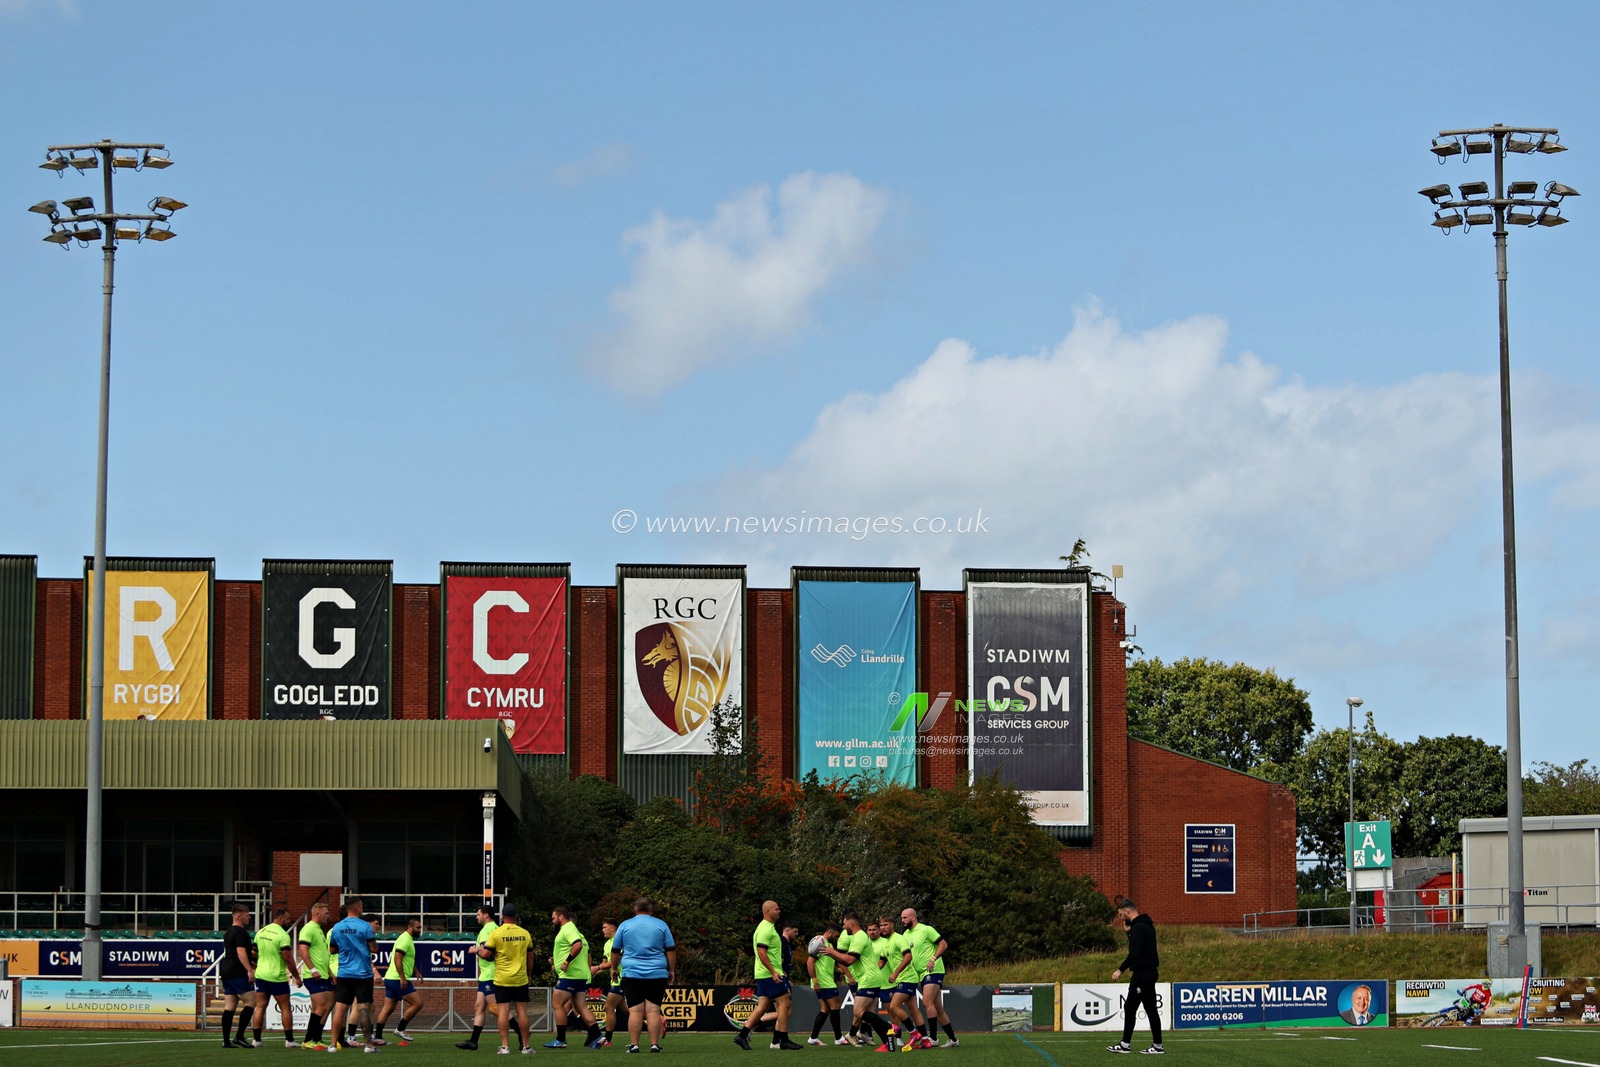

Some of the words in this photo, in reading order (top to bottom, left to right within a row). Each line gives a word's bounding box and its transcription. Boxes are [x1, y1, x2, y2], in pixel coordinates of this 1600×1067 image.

[652, 596, 717, 620] RGC
[118, 586, 177, 671] R
[299, 587, 356, 669] G
[473, 590, 530, 675] C
[861, 654, 905, 663] Llandrillo
[987, 649, 1070, 664] STADIWM
[113, 684, 181, 704] RYGBI
[273, 684, 379, 706] GOGLEDD
[467, 687, 545, 708] CYMRU
[987, 675, 1070, 713] CSM
[987, 719, 1032, 729] SERVICES
[1034, 719, 1070, 729] GROUP
[815, 738, 900, 750] www.gllm.ac.uk
[1359, 824, 1377, 832] Exit
[1362, 833, 1376, 848] A
[50, 951, 82, 966] CSM
[109, 951, 169, 962] STADIWM
[185, 949, 214, 962] CSM
[431, 950, 465, 965] CSM
[664, 988, 714, 1006] XHAM
[1180, 988, 1255, 1003] DARREN
[1261, 986, 1328, 1002] MILLAR
[66, 1002, 128, 1010] LLANDUDNO
[129, 1003, 150, 1011] PIER
[724, 1004, 757, 1013] WREXHA
[1181, 1013, 1202, 1021] 0300
[1222, 1012, 1244, 1020] 6206
